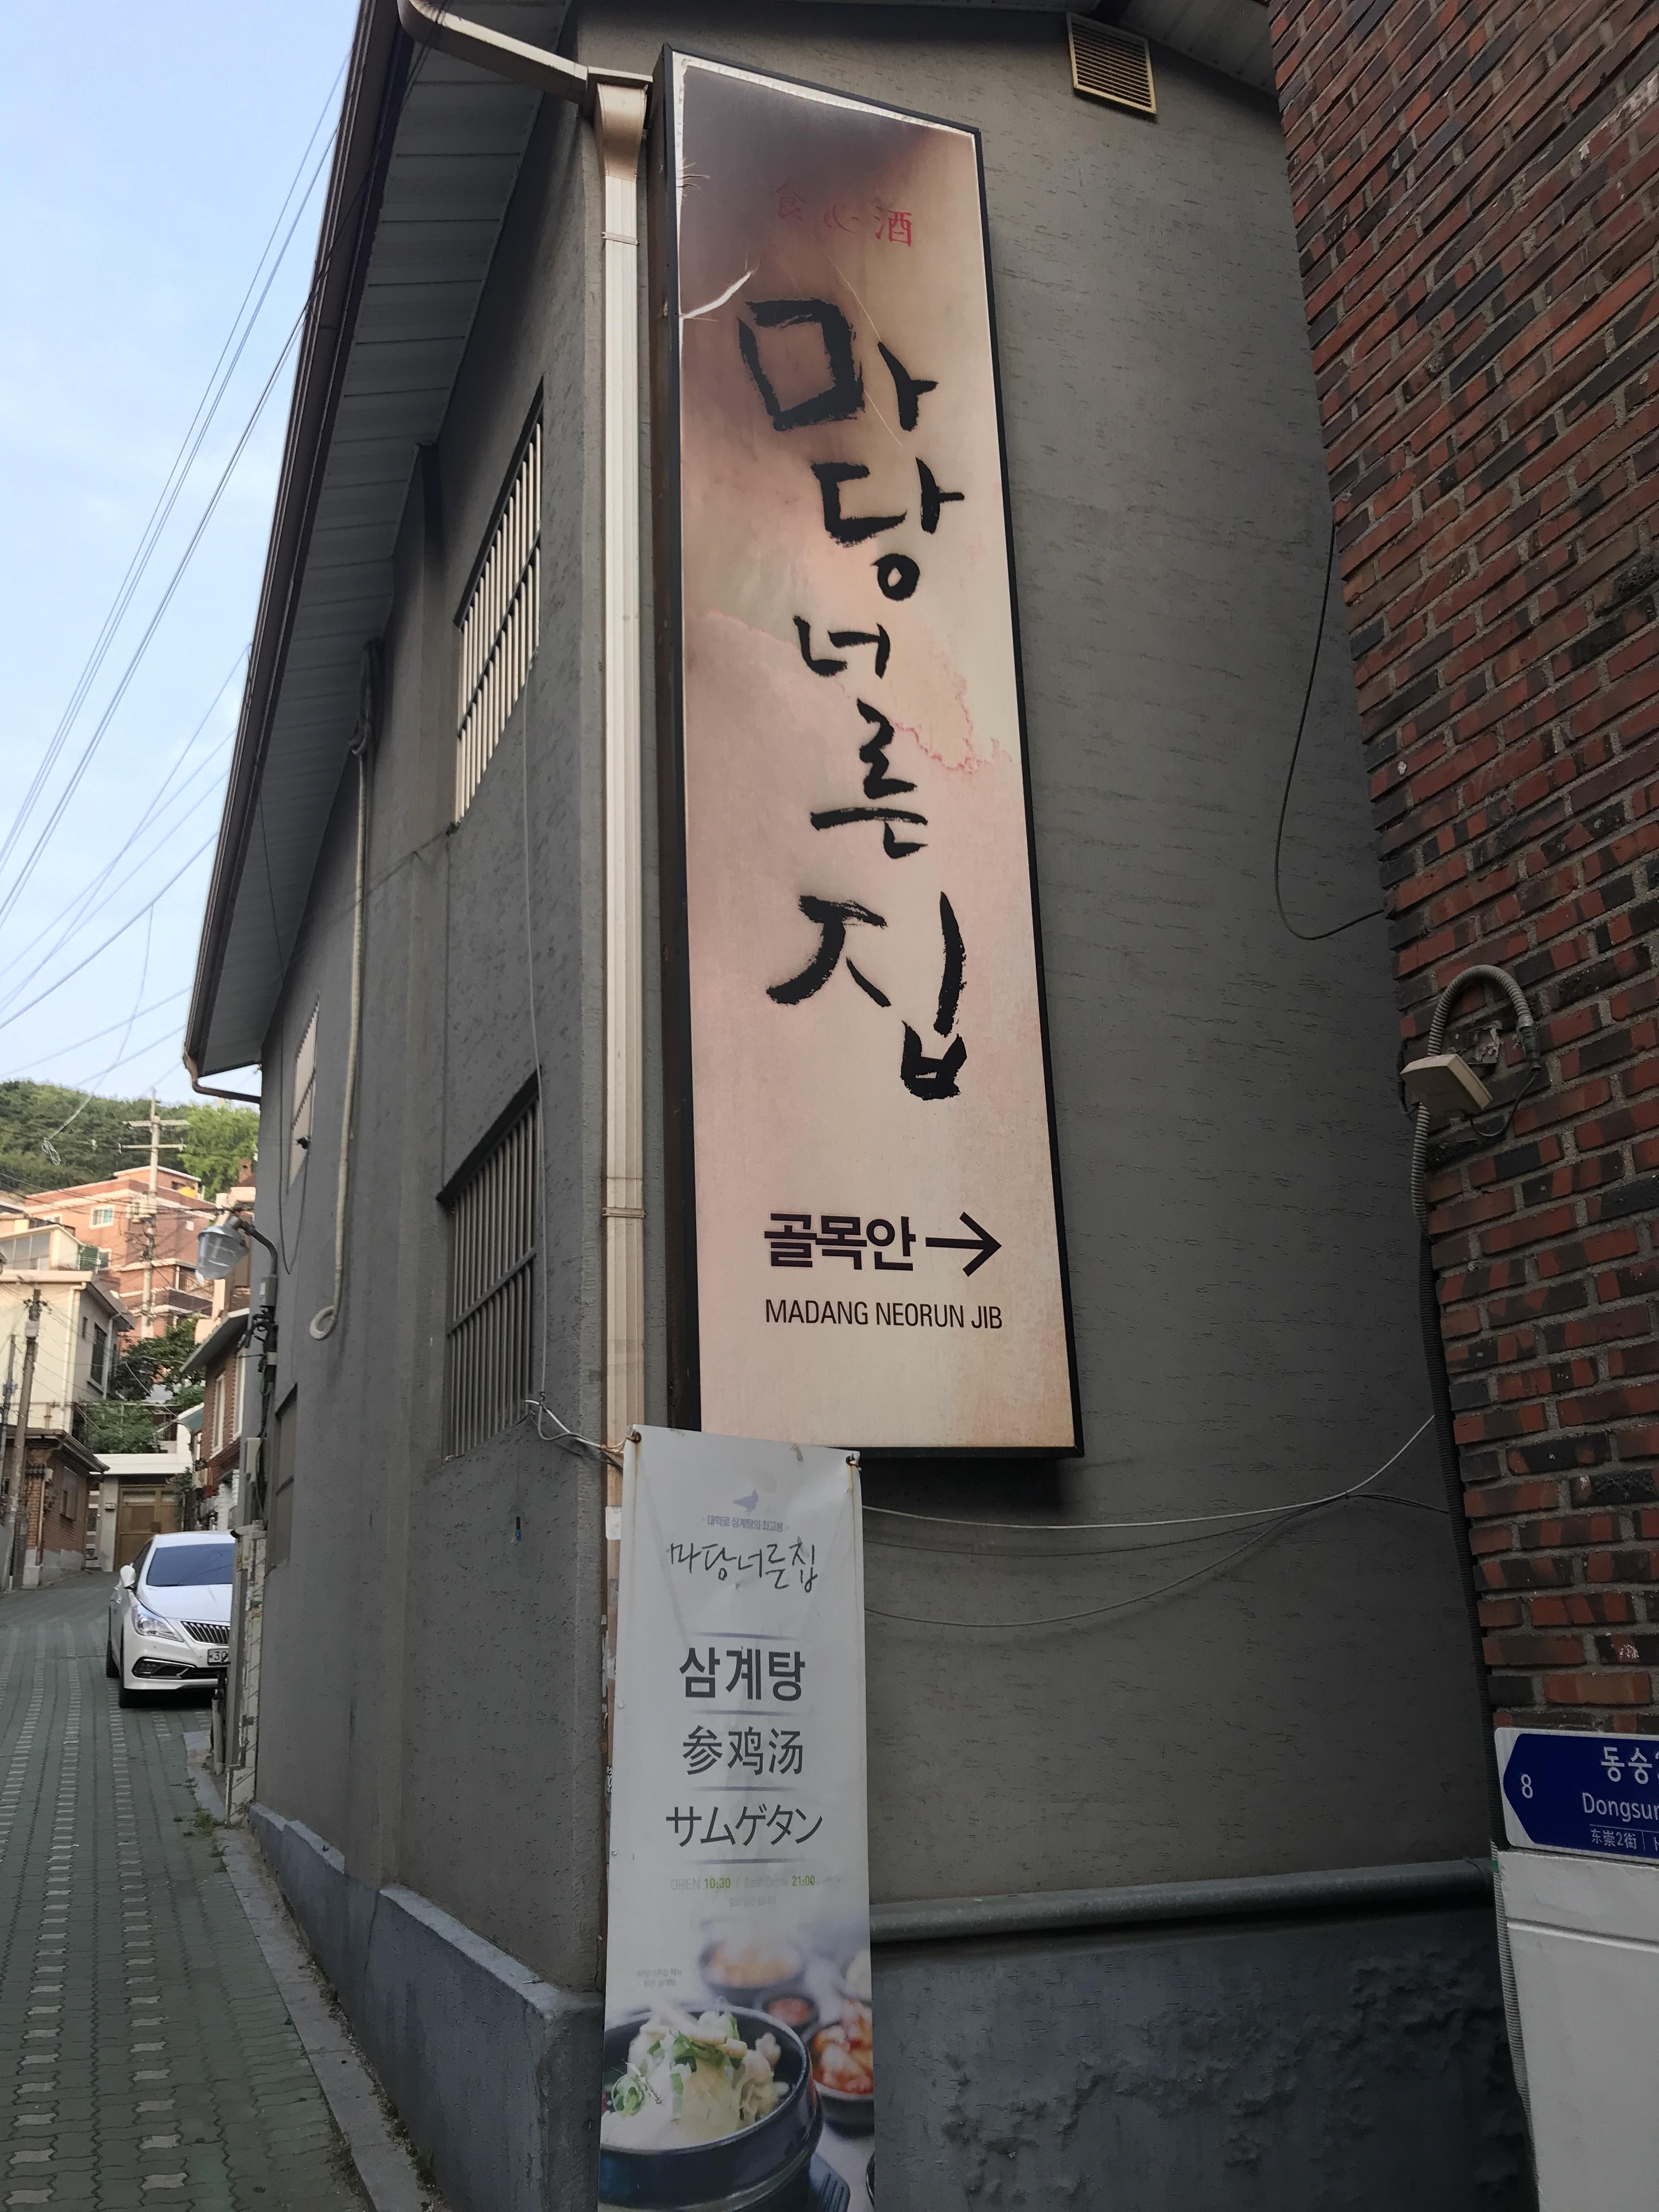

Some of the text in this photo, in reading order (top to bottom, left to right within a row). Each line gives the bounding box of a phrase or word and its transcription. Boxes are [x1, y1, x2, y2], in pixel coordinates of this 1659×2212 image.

[764, 1212, 916, 1271] 골목안
[765, 1299, 1003, 1329] MADANG NEORUN JIB
[679, 1646, 806, 1701] 삼계탕
[682, 1725, 804, 1776] 参鸡汤
[1600, 1746, 1659, 1785] 동숭
[1521, 1774, 1533, 1799] 8
[665, 1803, 823, 1848] サムゲタン
[670, 1878, 701, 1891] OPEN
[704, 1877, 731, 1889] 10:30
[792, 1875, 815, 1887] 21:00
